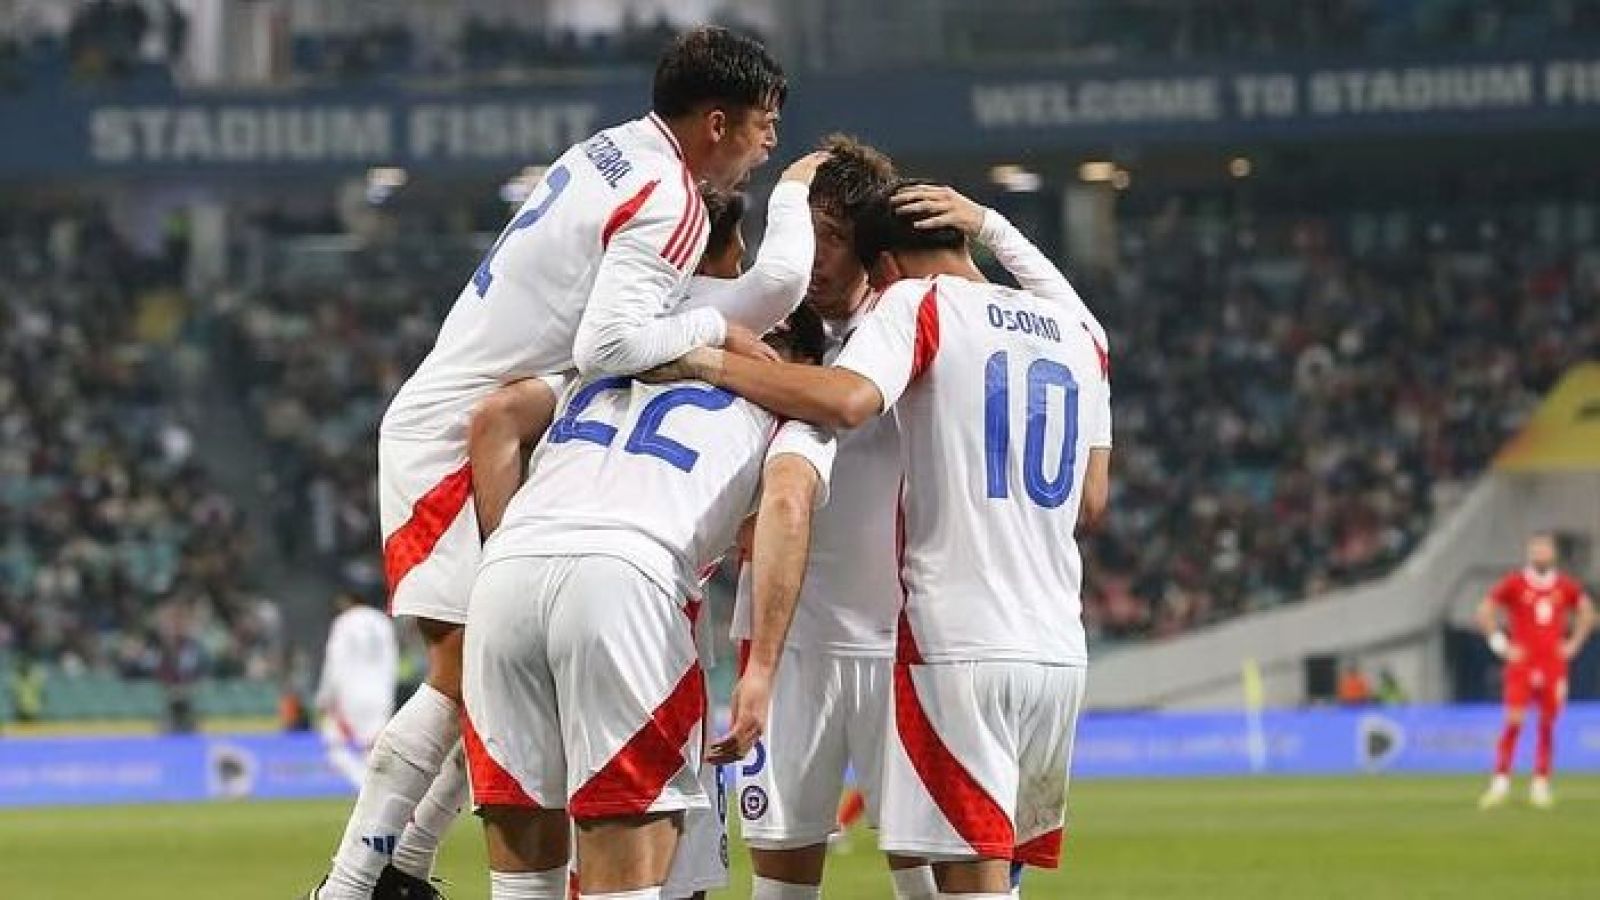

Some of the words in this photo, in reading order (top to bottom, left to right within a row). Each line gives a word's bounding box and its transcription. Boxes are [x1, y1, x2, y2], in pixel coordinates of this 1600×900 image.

[91, 106, 390, 161] STADIUM
[410, 103, 598, 157] FISHT
[972, 78, 1219, 127] WELCOME
[1236, 74, 1297, 117] TO
[1308, 64, 1531, 113] STADIUM
[547, 375, 735, 475] 22
[984, 349, 1079, 509] 10
